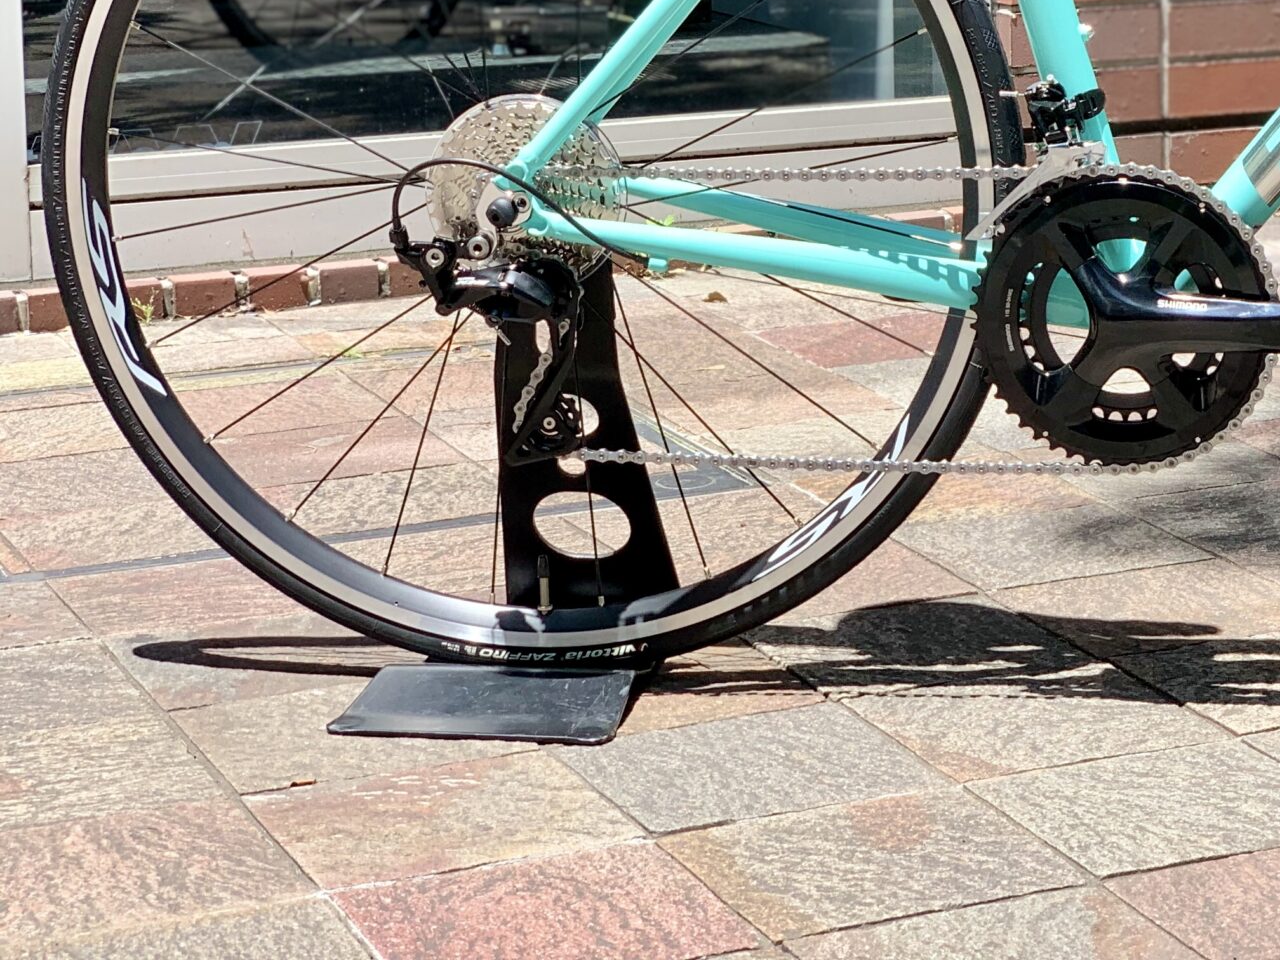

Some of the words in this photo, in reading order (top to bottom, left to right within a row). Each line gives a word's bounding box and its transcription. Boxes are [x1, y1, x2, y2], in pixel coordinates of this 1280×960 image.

[1157, 299, 1208, 311] SHIMANO
[478, 648, 557, 661] ZAFFIRO
[564, 643, 635, 660] vittoria
